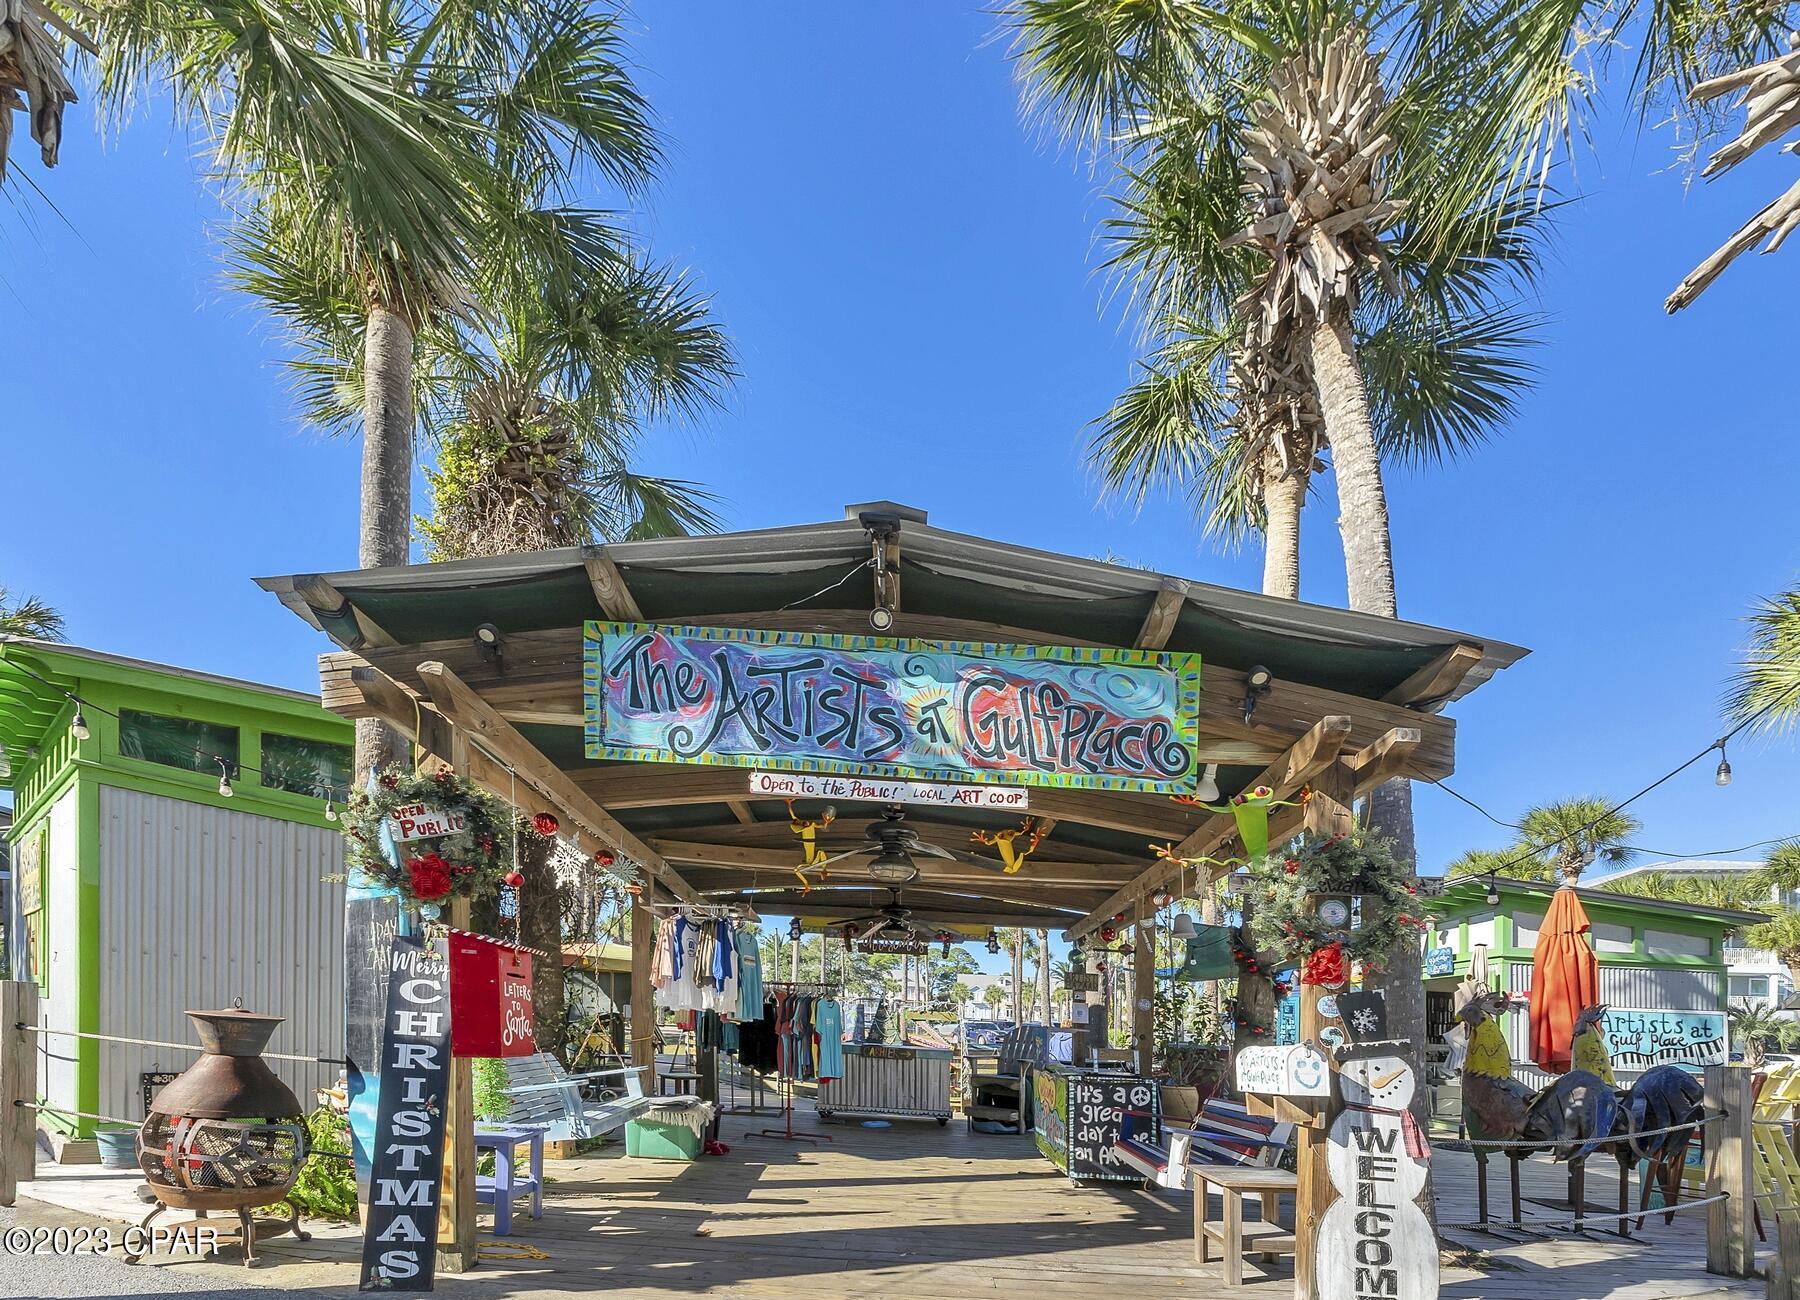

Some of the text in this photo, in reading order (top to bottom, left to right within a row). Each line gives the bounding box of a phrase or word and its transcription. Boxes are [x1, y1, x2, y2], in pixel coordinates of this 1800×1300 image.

[610, 634, 707, 713] The
[760, 775, 794, 793] Open
[799, 777, 814, 793] to
[822, 778, 846, 795] the
[913, 788, 946, 800] LOCAL
[952, 790, 983, 804] ART
[391, 803, 426, 820] OPEN
[400, 816, 463, 838] PUBLIC
[392, 950, 450, 981] Merry
[512, 1000, 521, 1011] TO
[503, 1009, 532, 1046] Santa
[1601, 1011, 1713, 1038] Artists at
[1076, 1084, 1103, 1104] It's
[374, 979, 444, 1279] CHRISTMAS
[1075, 1147, 1093, 1162] an
[1351, 1126, 1399, 1300] WELCOM
